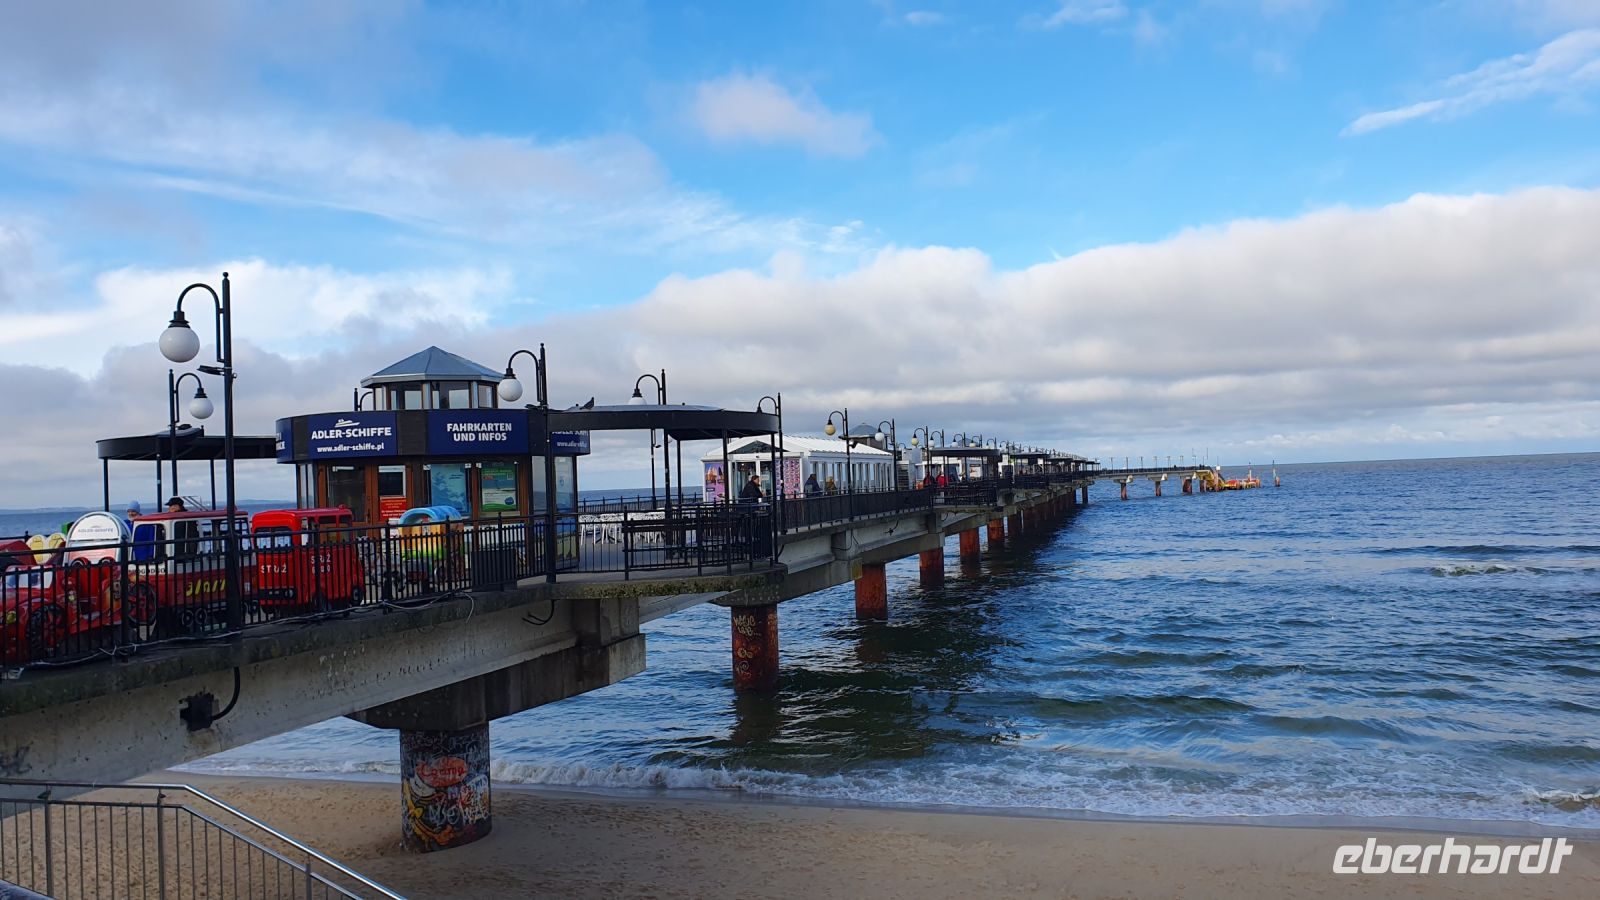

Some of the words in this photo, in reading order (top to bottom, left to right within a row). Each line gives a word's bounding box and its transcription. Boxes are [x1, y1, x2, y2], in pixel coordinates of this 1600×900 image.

[446, 423, 512, 432] FAHRKARTEN
[311, 427, 392, 440] ADLER-SCHIFFE
[453, 432, 476, 442] UND
[478, 432, 507, 441] INFOS
[316, 442, 385, 453] www.adler-schiffe.pl
